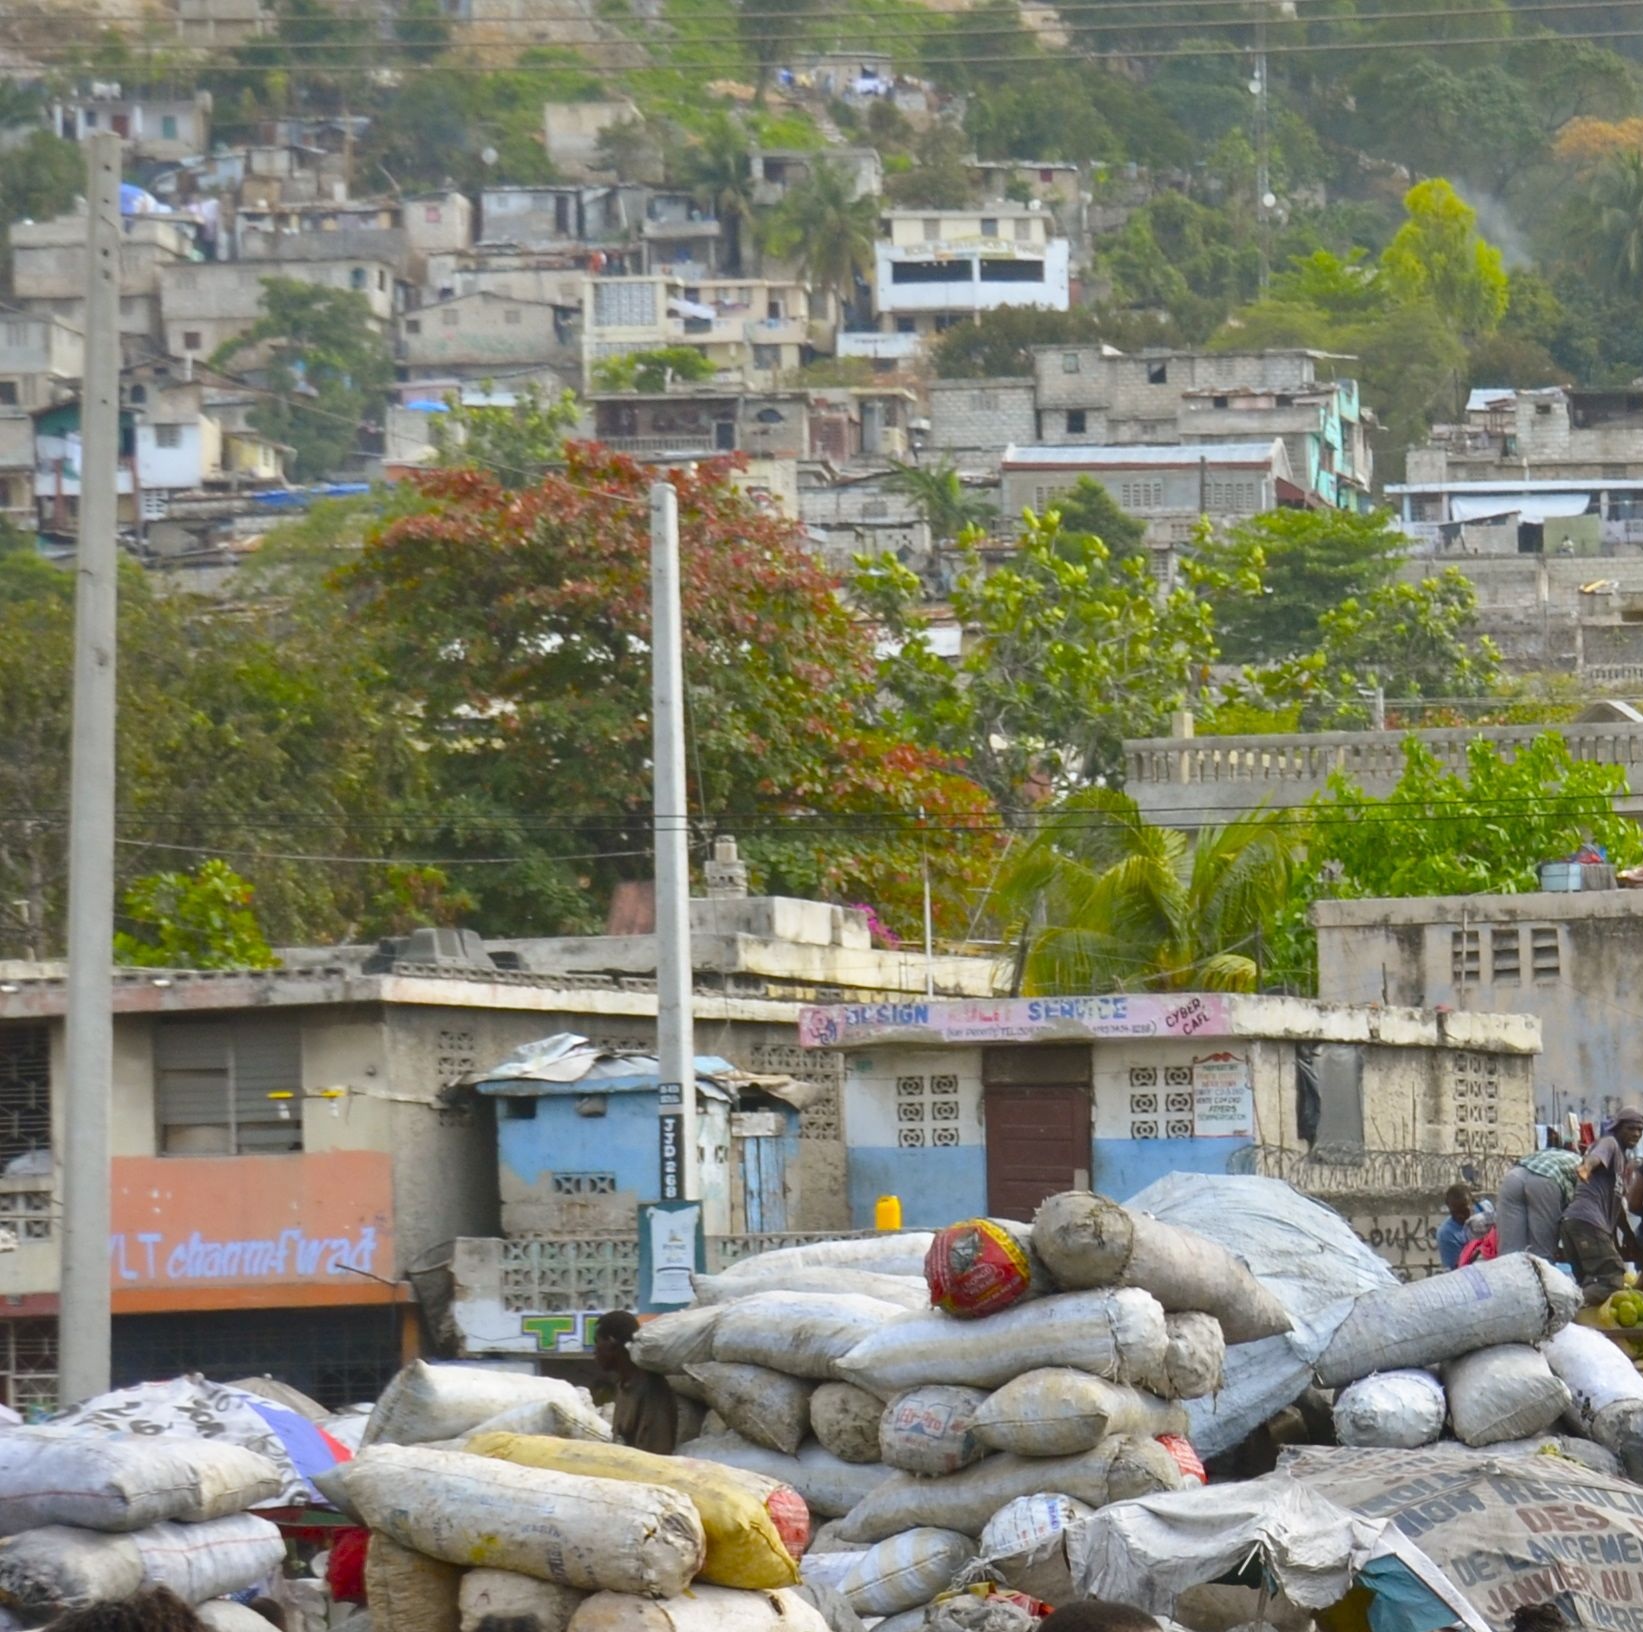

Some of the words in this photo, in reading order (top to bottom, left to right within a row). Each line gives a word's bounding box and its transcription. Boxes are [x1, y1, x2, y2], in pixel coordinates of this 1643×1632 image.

[1028, 997, 1128, 1021] SERVICE
[1516, 1503, 1610, 1534] DES
[1603, 1570, 1633, 1602] AU
